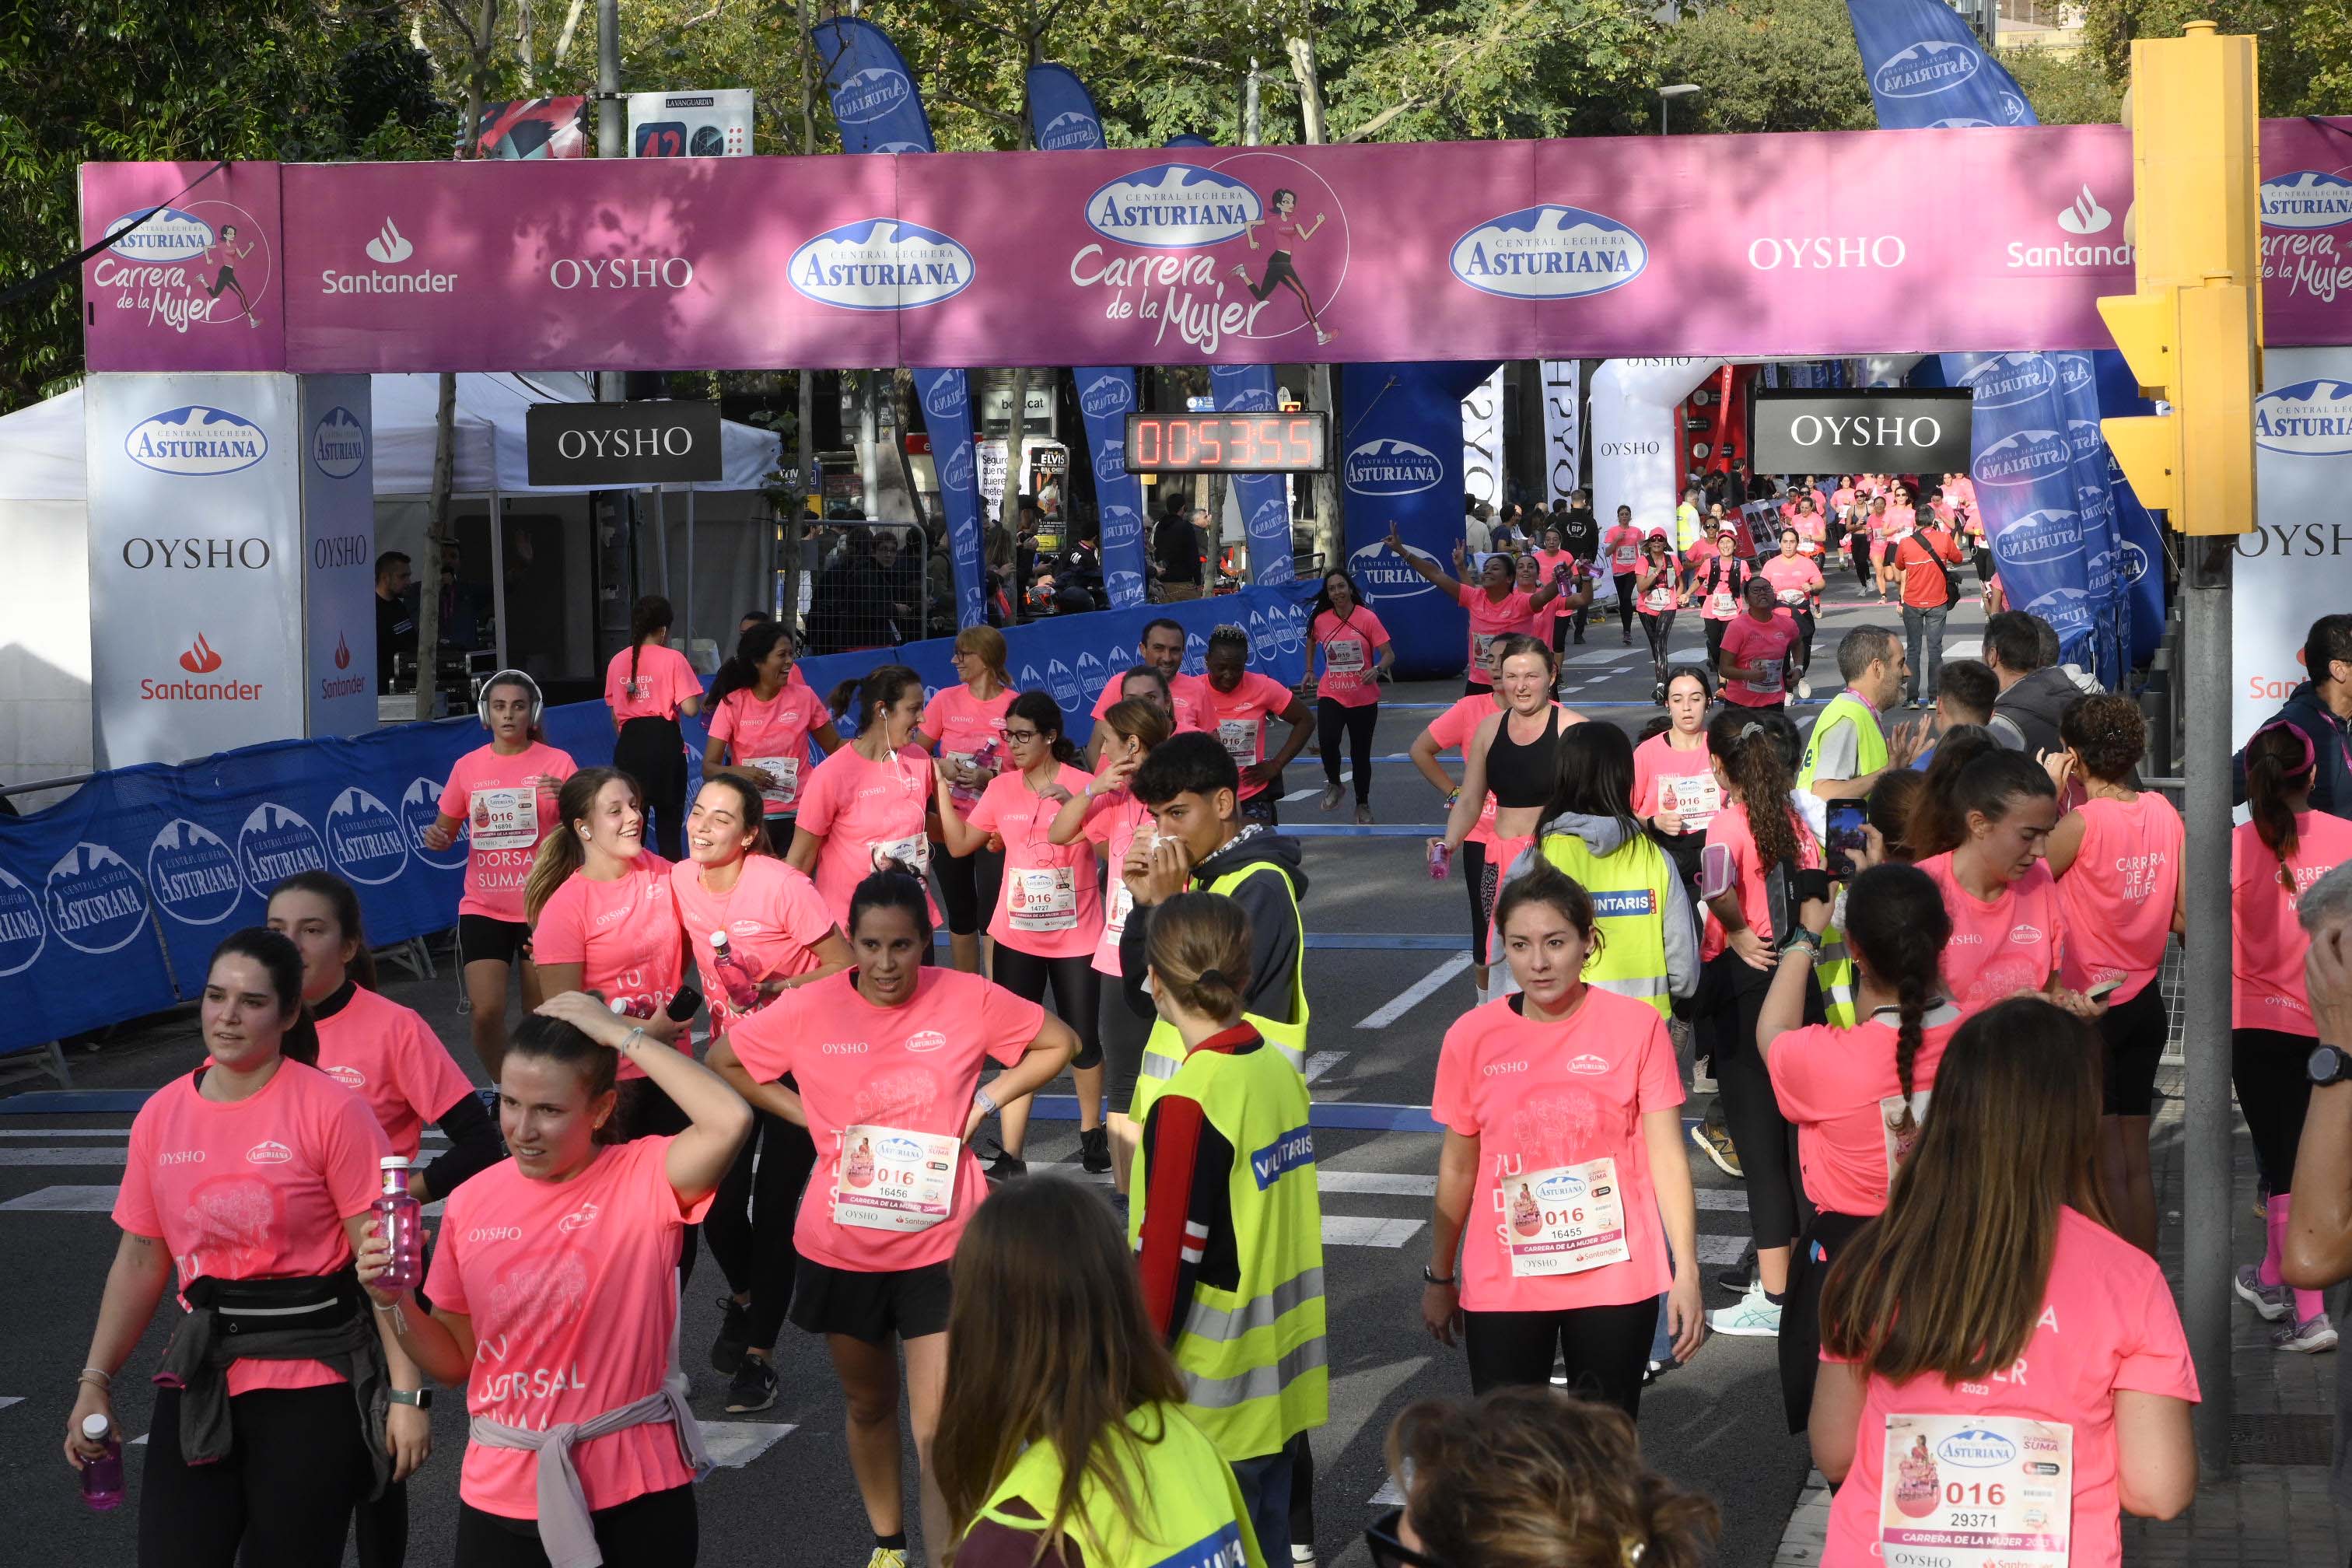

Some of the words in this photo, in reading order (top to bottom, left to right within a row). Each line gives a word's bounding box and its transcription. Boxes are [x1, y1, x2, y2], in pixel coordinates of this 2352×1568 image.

[1126, 192, 1181, 201] CENTRAL
[1187, 191, 1244, 201] LECHERA
[2317, 189, 2352, 198] LECHER
[1098, 194, 1248, 227] ASTURIANA
[1495, 237, 1557, 247] CENTRAL
[1563, 236, 1626, 246] LECHERA
[2260, 233, 2335, 257] arrera
[831, 250, 889, 260] CENTRAL
[895, 248, 954, 259] LECHERA
[1465, 240, 1633, 276] ASTURIANA
[1747, 235, 1906, 271] OYSHO
[93, 258, 187, 289] Carrera
[549, 257, 695, 290] OYSHO
[802, 252, 961, 287] ASTURIANA
[1069, 243, 1216, 288] Carrera
[321, 269, 459, 295] Santander
[2279, 256, 2293, 278] la
[2289, 252, 2352, 303] Muje
[117, 289, 134, 310] de
[138, 286, 150, 310] la
[147, 285, 221, 334] Mujer
[1106, 289, 1133, 320] de
[1139, 287, 1159, 320] la
[1154, 281, 1270, 355] Mujer
[2277, 405, 2329, 415] CENTRAL
[158, 429, 202, 438] CENTRAL
[205, 429, 254, 438] LECHERA
[1790, 415, 1941, 448] OYSHO
[136, 432, 258, 459] ASTURIANA
[316, 440, 362, 461] ASTURIANA
[558, 426, 694, 460] OYSHO
[1601, 441, 1661, 457] OYSHO
[1041, 453, 1065, 464] ELVIS
[982, 467, 996, 475] que
[1348, 460, 1436, 483] ASTURIANA
[983, 478, 1006, 487] quiere
[122, 537, 271, 569] OYSHO
[314, 534, 367, 569] OYSHO
[321, 674, 366, 700] Santander
[619, 675, 653, 684] CARERA
[140, 678, 263, 700] Santander
[1679, 797, 1700, 807] 016
[491, 812, 514, 822] 016
[333, 827, 405, 865] ASTURIANA
[246, 845, 324, 884] ASTURIANA
[477, 851, 535, 868] DORSA
[2116, 852, 2166, 872] CARRRA
[156, 863, 239, 904] ASTURIANA
[478, 871, 527, 888] SUMA
[2126, 870, 2141, 885] DE
[1027, 894, 1052, 904] 016
[597, 906, 631, 926] OYSHO
[1948, 933, 1983, 946] YSHO
[821, 1042, 869, 1055] OYSHO
[1483, 1060, 1528, 1077] OYSHO
[159, 1150, 205, 1166] OYSHO
[877, 1168, 915, 1185] 016
[1588, 1173, 1608, 1183] SUMA
[880, 1187, 908, 1199] 16456
[1539, 1185, 1584, 1197] ASTURIANA
[849, 1196, 880, 1206] CARRERA
[845, 1209, 878, 1221] OYSHO
[1545, 1207, 1584, 1226] 016
[468, 1227, 522, 1243] OYSHO
[1551, 1227, 1583, 1240] 16455
[1524, 1244, 1555, 1253] CARRERA
[1576, 1237, 1598, 1248] MUJER
[177, 1255, 199, 1281] TU
[1524, 1258, 1557, 1269] OYSHO
[1961, 1382, 1990, 1397] 2023
[1943, 1444, 2011, 1460] ASTURIANA
[2023, 1441, 2060, 1452] SUMA
[1945, 1482, 2007, 1506] 016
[1950, 1513, 1997, 1528] 29371
[1902, 1533, 1951, 1545] CARRERA
[1954, 1535, 1969, 1545] DE
[1970, 1535, 1985, 1545] LA
[1987, 1536, 2023, 1547] MUJER
